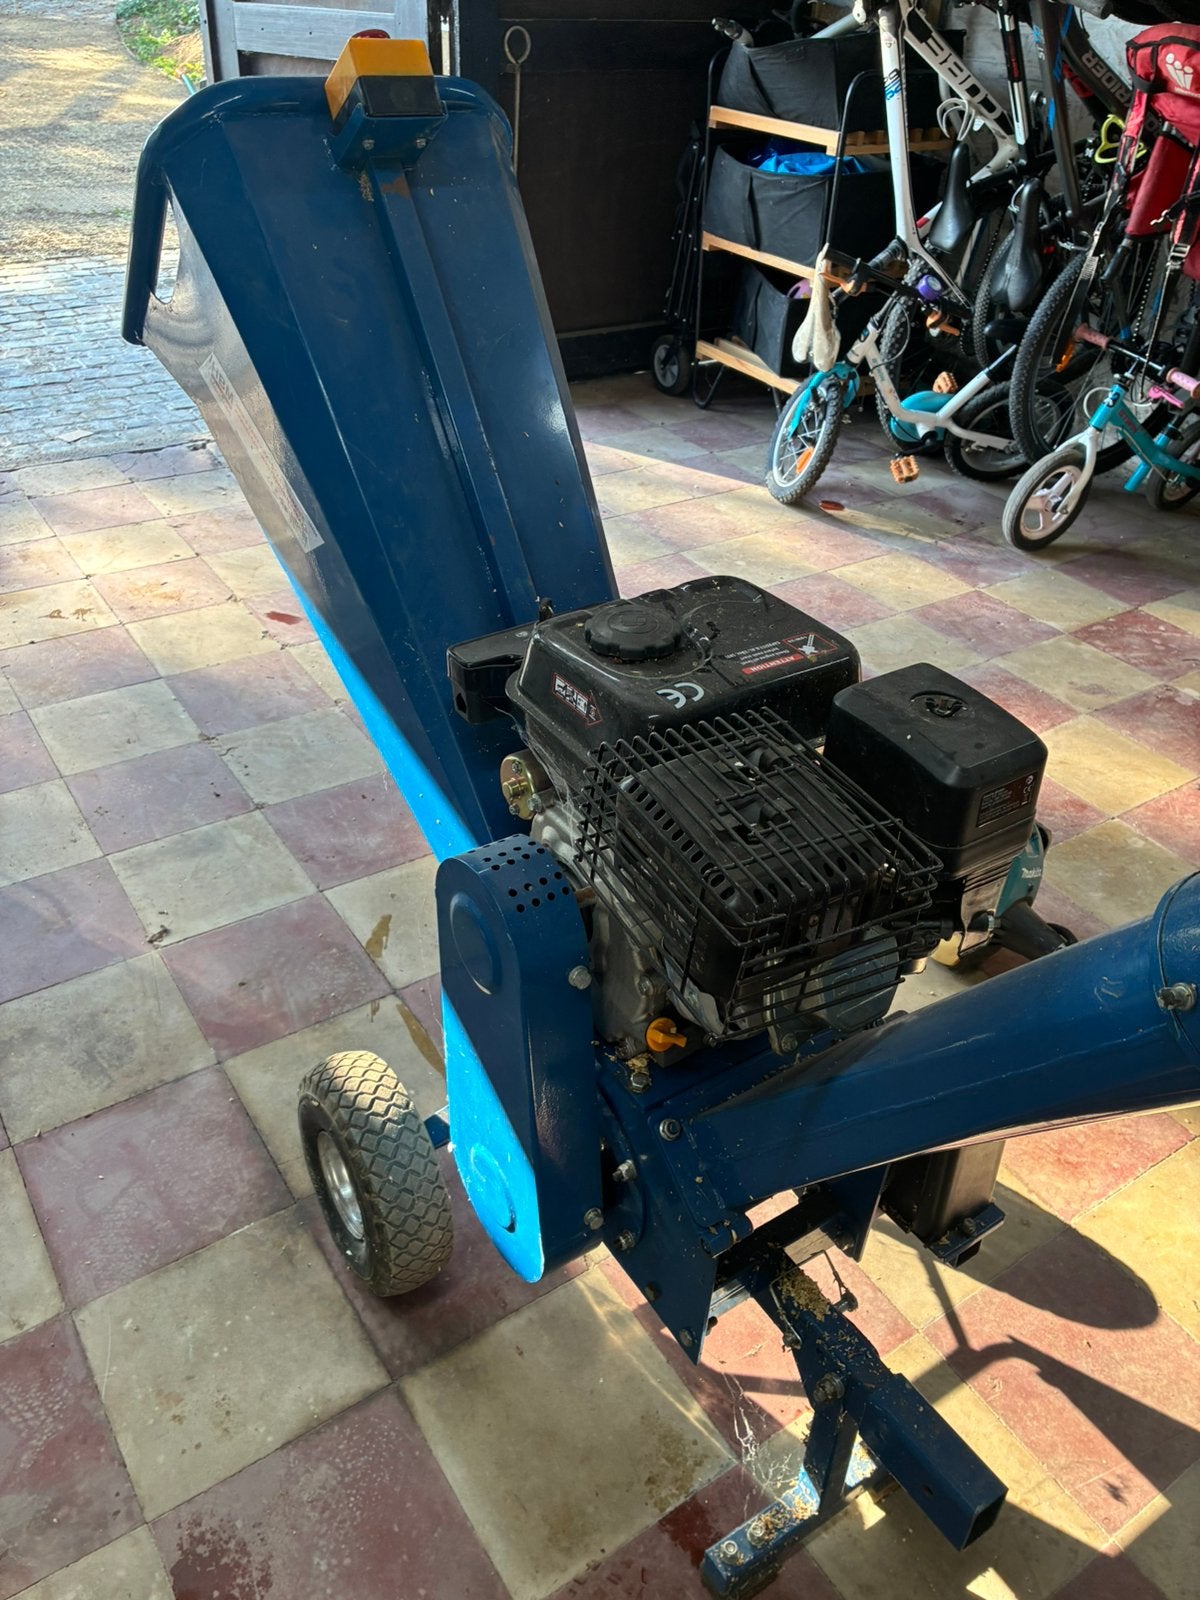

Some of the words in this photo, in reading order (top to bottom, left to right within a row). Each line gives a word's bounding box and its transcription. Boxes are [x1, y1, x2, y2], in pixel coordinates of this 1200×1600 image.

[921, 34, 1001, 119] CUBE
[751, 656, 794, 672] ATTENTION
[656, 682, 704, 709] CE
